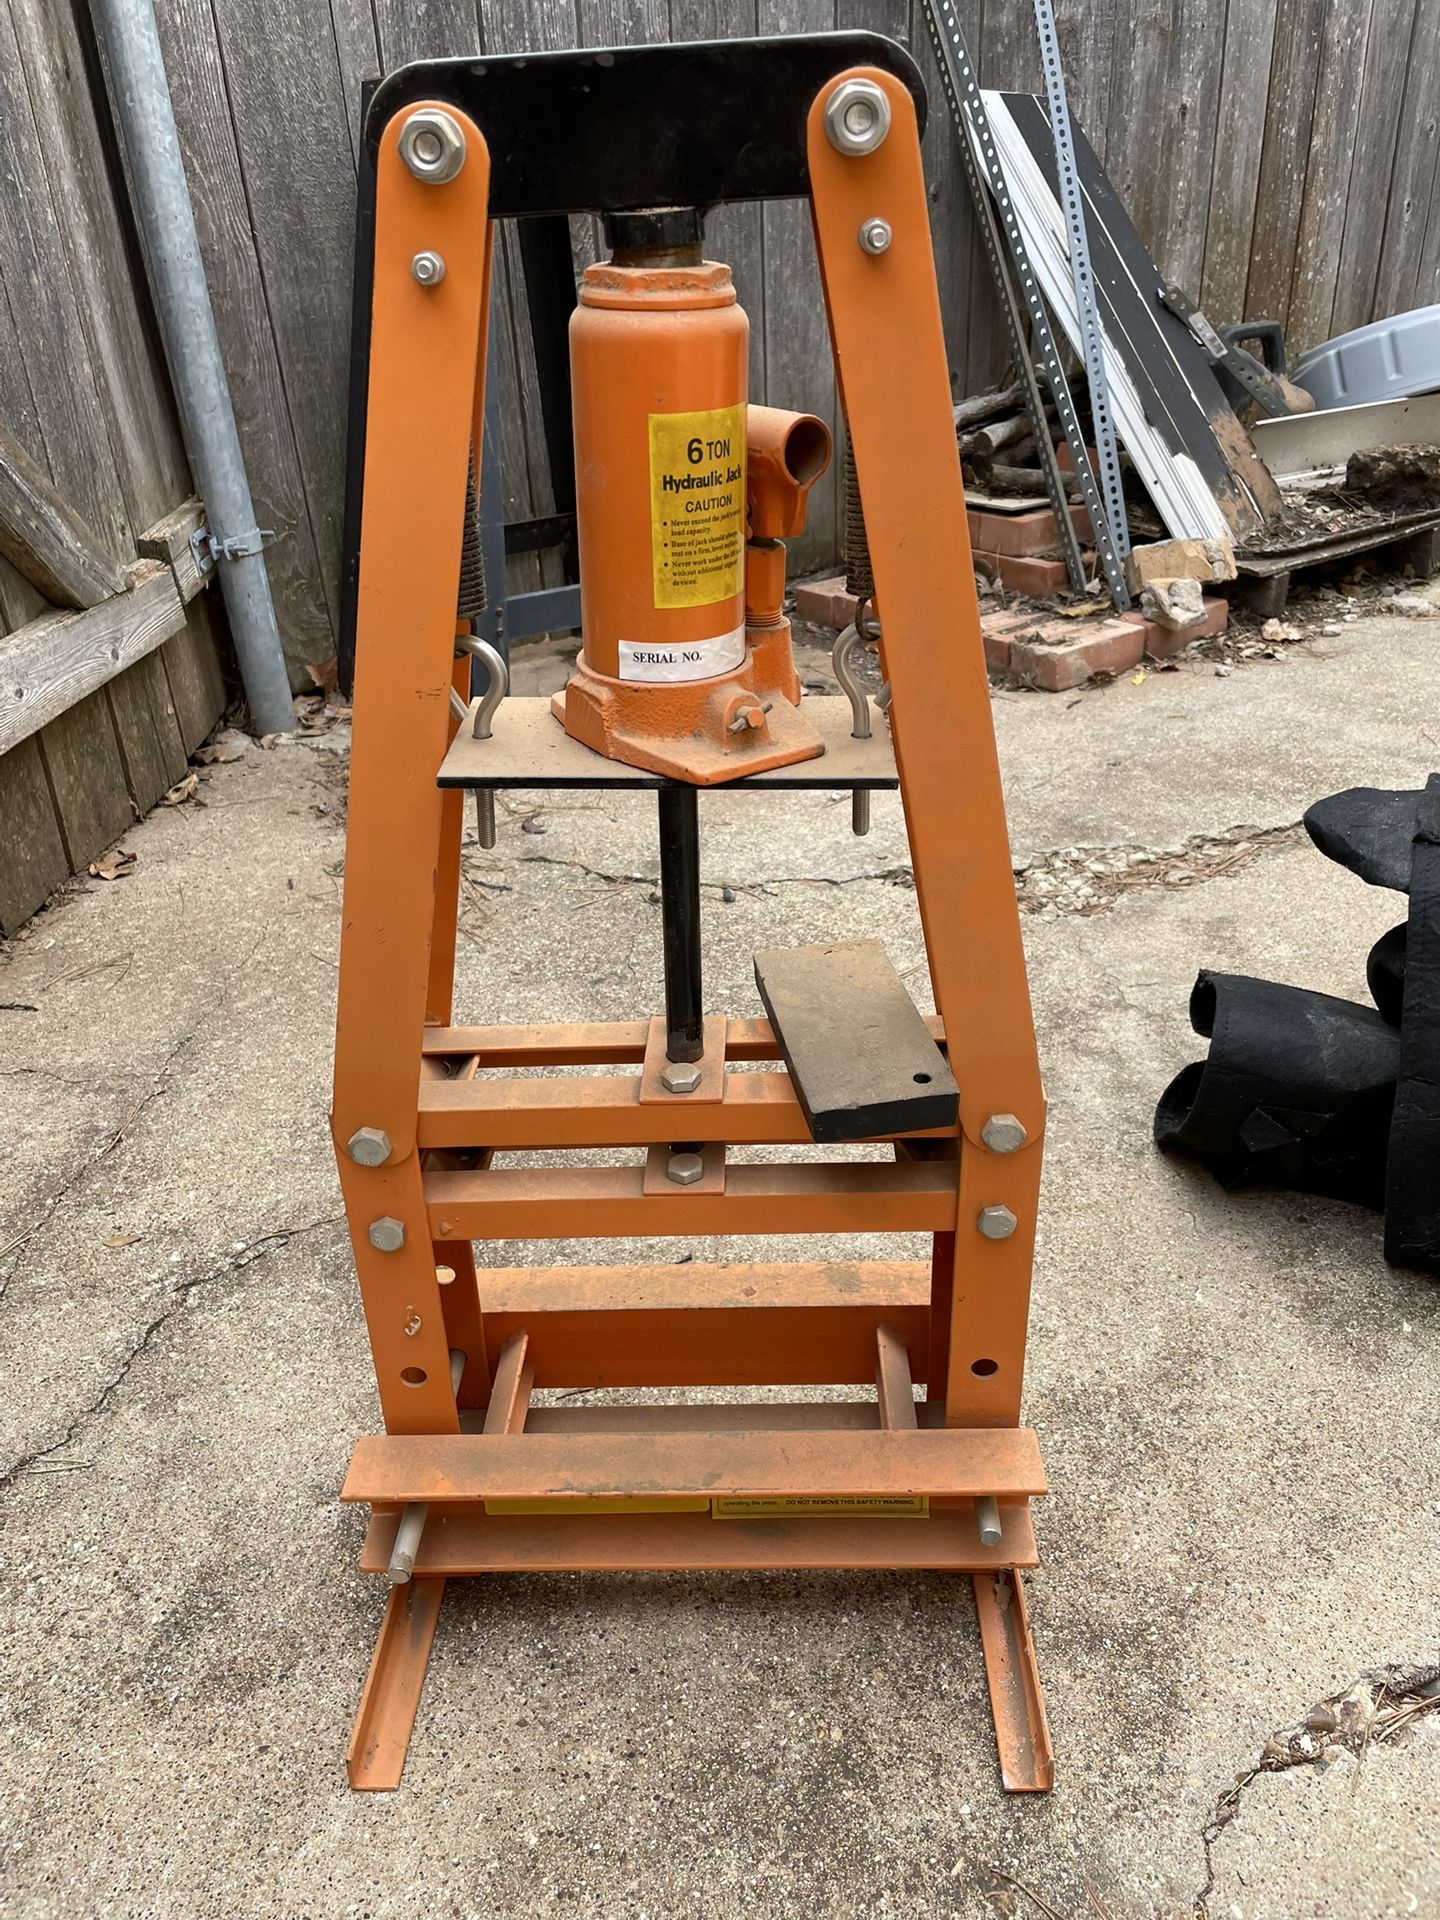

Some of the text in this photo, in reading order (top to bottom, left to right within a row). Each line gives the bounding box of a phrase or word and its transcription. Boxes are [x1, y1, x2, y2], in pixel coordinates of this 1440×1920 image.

[687, 437, 730, 464] 6 TON
[662, 464, 742, 494] Hydraulic Jack
[685, 493, 732, 513] CAUTION
[691, 516, 712, 525] exceed
[671, 540, 686, 548] Base
[695, 538, 707, 548] jack
[672, 560, 691, 568] Never
[693, 558, 707, 566] work
[672, 569, 696, 577] without
[697, 564, 722, 575] additional
[632, 651, 702, 664] SERIAL NO.
